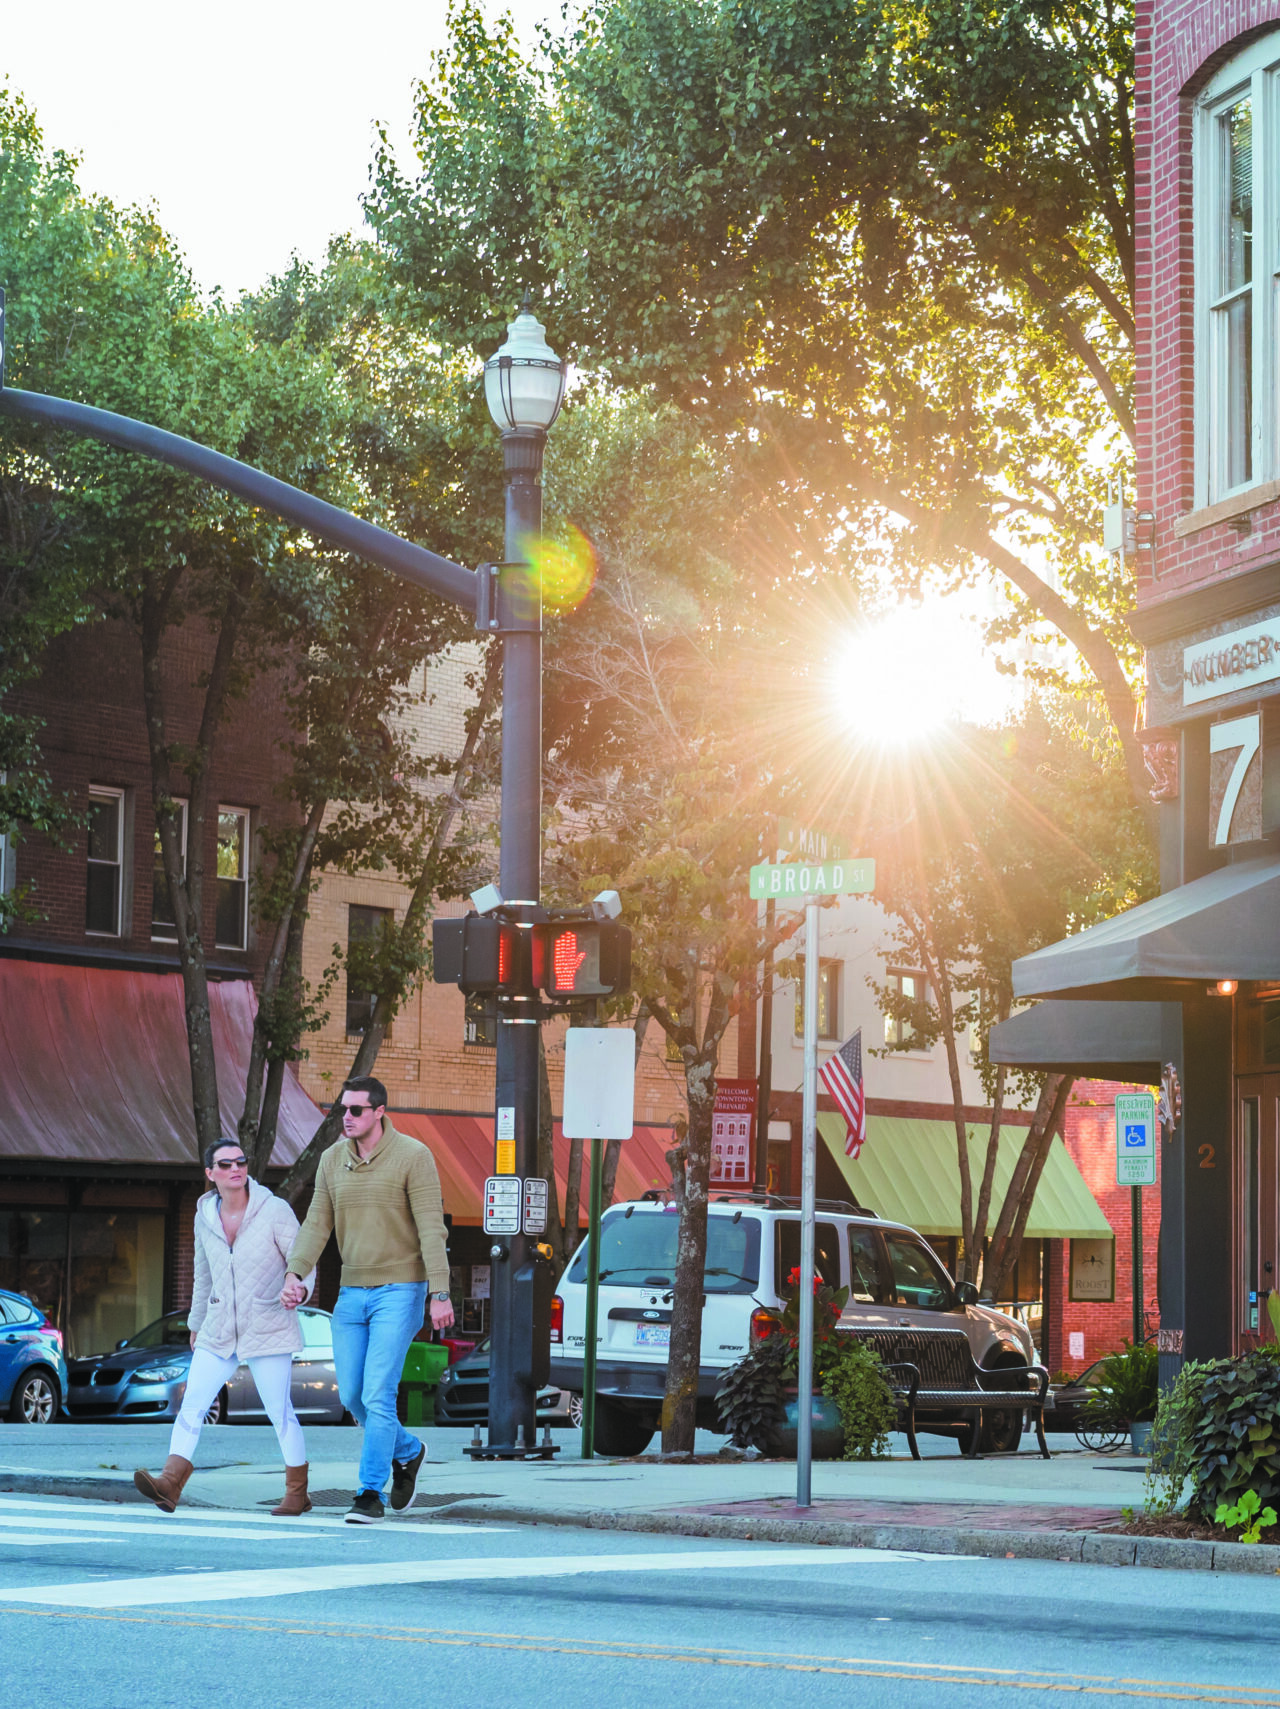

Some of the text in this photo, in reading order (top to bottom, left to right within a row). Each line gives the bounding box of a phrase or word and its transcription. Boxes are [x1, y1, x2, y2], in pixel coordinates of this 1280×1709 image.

[1190, 634, 1274, 688] NUMBER
[1210, 714, 1260, 845] 7
[799, 827, 828, 859] MAIN
[758, 865, 865, 893] N BROAD ST
[1118, 1099, 1151, 1109] RESERVED
[1121, 1110, 1149, 1120] PARKING
[1198, 1143, 1216, 1169] 2
[1076, 1279, 1110, 1289] ROOST
[567, 1335, 603, 1343] EXPLR
